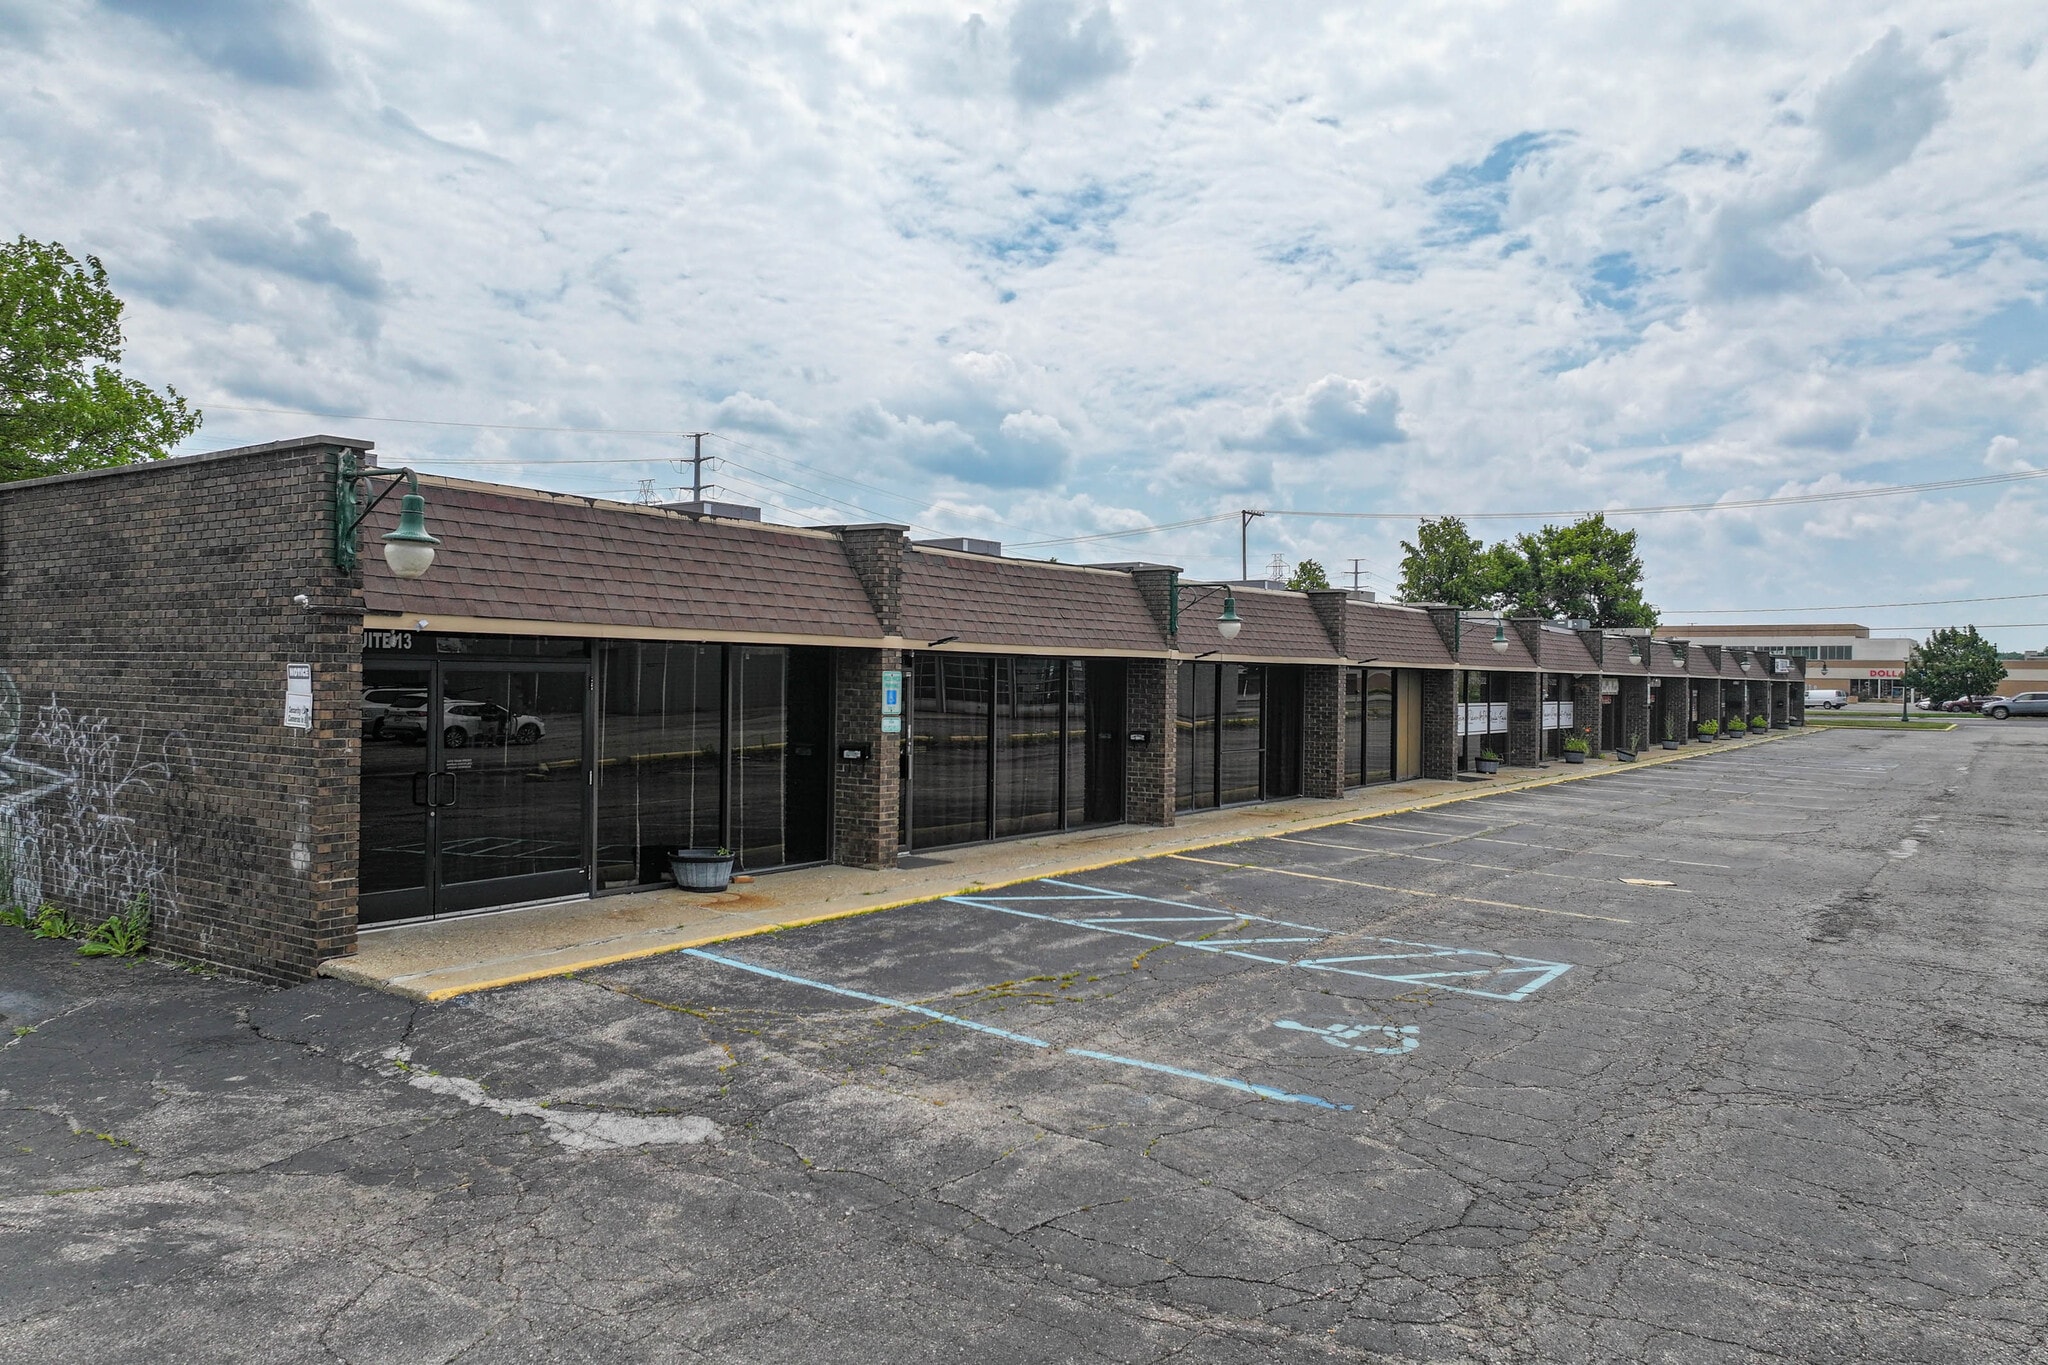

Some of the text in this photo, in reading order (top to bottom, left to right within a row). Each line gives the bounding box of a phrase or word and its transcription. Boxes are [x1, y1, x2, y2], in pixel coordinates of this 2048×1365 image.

[362, 631, 412, 650] UITE 13
[289, 667, 309, 677] NOTICE
[1869, 670, 1905, 678] DOLLA
